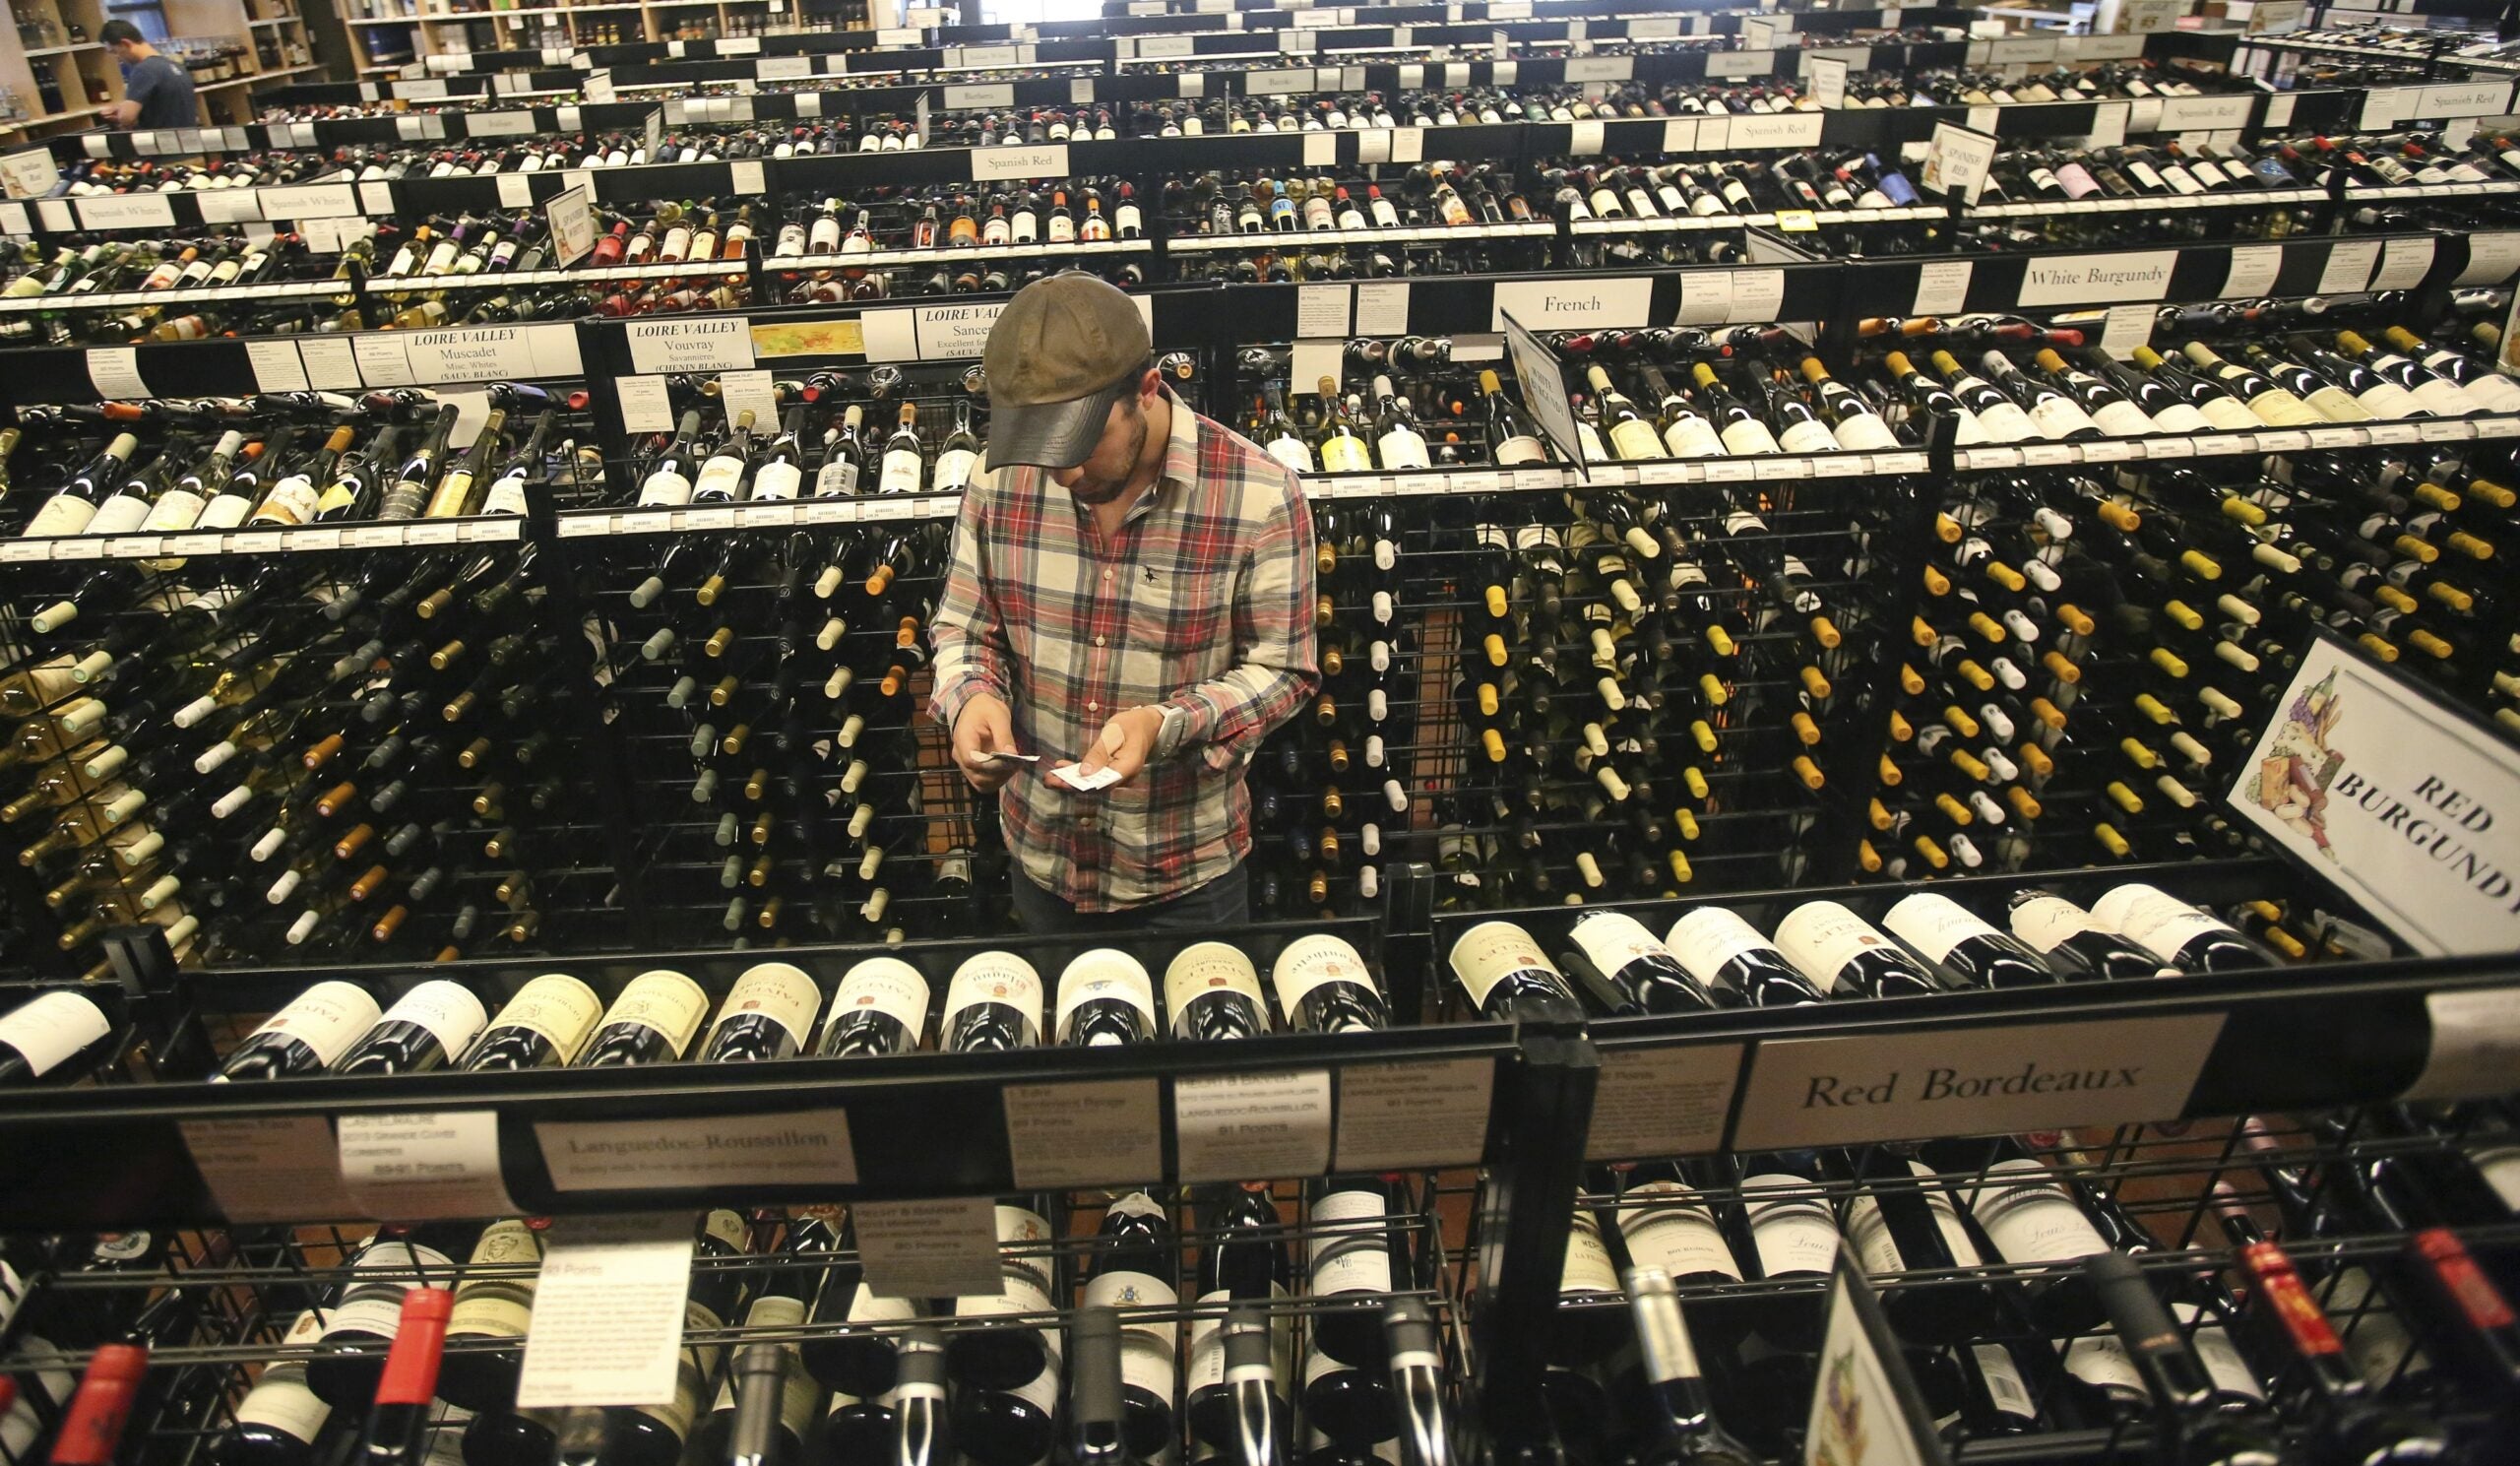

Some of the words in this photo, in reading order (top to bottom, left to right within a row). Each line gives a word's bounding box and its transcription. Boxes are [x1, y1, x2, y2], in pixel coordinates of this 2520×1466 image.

[2433, 96, 2472, 108] Spanish
[2475, 93, 2495, 104] Red
[2176, 107, 2214, 120] Spanish
[2217, 105, 2236, 117] Red
[1745, 125, 1783, 138] Spanish
[1787, 124, 1806, 135] Red
[988, 156, 1029, 170] Spanish
[1033, 156, 1053, 166] Red
[2032, 269, 2080, 286] White
[2087, 265, 2168, 286] Burgundy
[1544, 294, 1602, 313] French
[925, 308, 971, 322] LOIRE
[976, 307, 1000, 319] VAL
[637, 324, 679, 338] LOIRE
[684, 321, 739, 335] VALLEY
[414, 332, 458, 346] LOIRE
[461, 329, 517, 344] VALLEY
[937, 340, 975, 349] Excellent
[664, 340, 715, 351] Vouvray
[440, 347, 497, 360] Muscadet
[470, 360, 498, 369] Whites
[656, 362, 695, 372] (CHENIN
[698, 361, 733, 371] BLANC)
[440, 370, 472, 381] (SAUV.
[473, 369, 509, 379] BLANC)
[2413, 774, 2493, 835] RED
[1802, 1073, 1897, 1111] Red
[1920, 1061, 2146, 1103] Bordeaux
[569, 1129, 829, 1156] Languedoc-Roussillon
